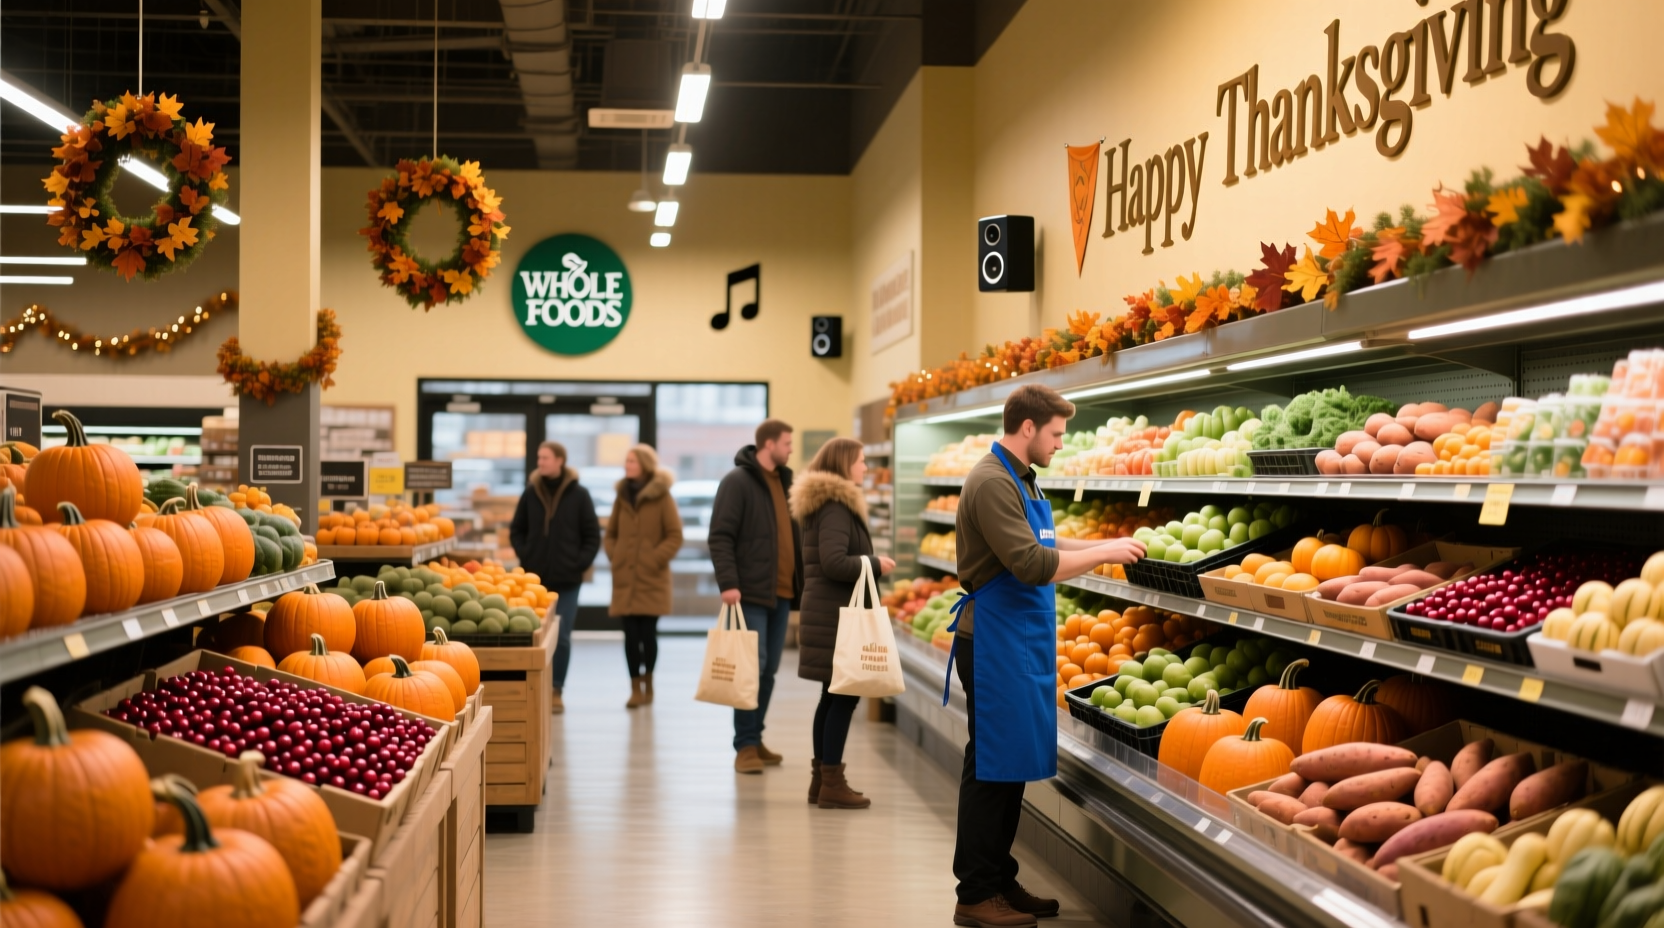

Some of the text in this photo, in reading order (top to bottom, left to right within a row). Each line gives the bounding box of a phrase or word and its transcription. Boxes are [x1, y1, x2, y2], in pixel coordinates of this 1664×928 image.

[1102, 0, 1576, 255] Happy Thanksgiving
[520, 266, 624, 300] WHOLE
[525, 299, 622, 327] FOODS
